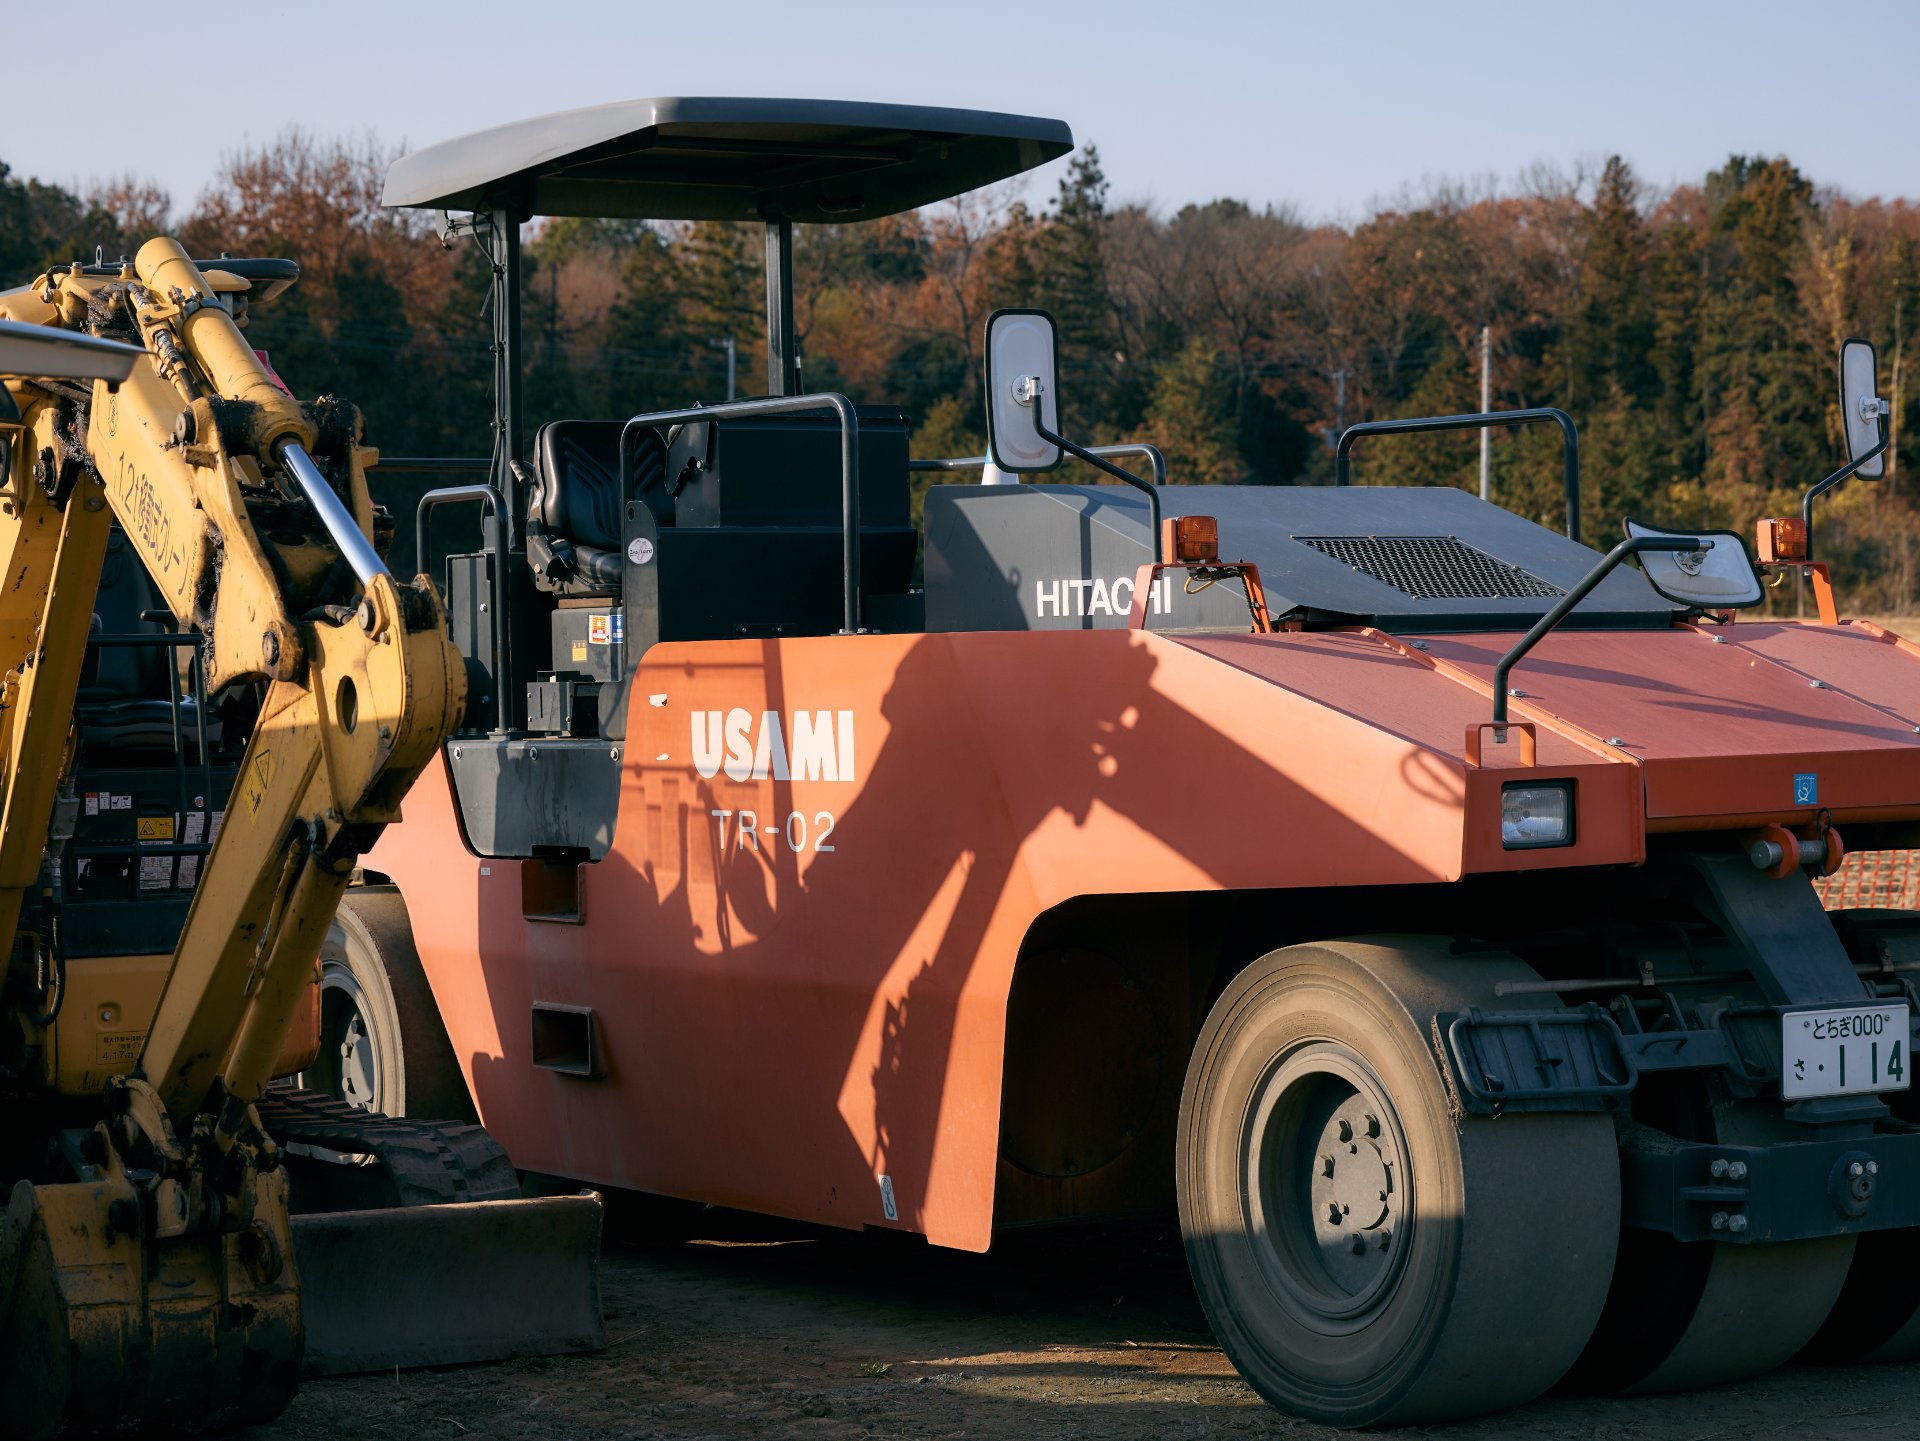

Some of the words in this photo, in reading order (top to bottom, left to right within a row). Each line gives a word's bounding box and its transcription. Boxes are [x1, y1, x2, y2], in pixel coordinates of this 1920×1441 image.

[690, 707, 855, 782] USAMI
[711, 809, 836, 853] TR-02
[1813, 1013, 1883, 1040] とちぎ000
